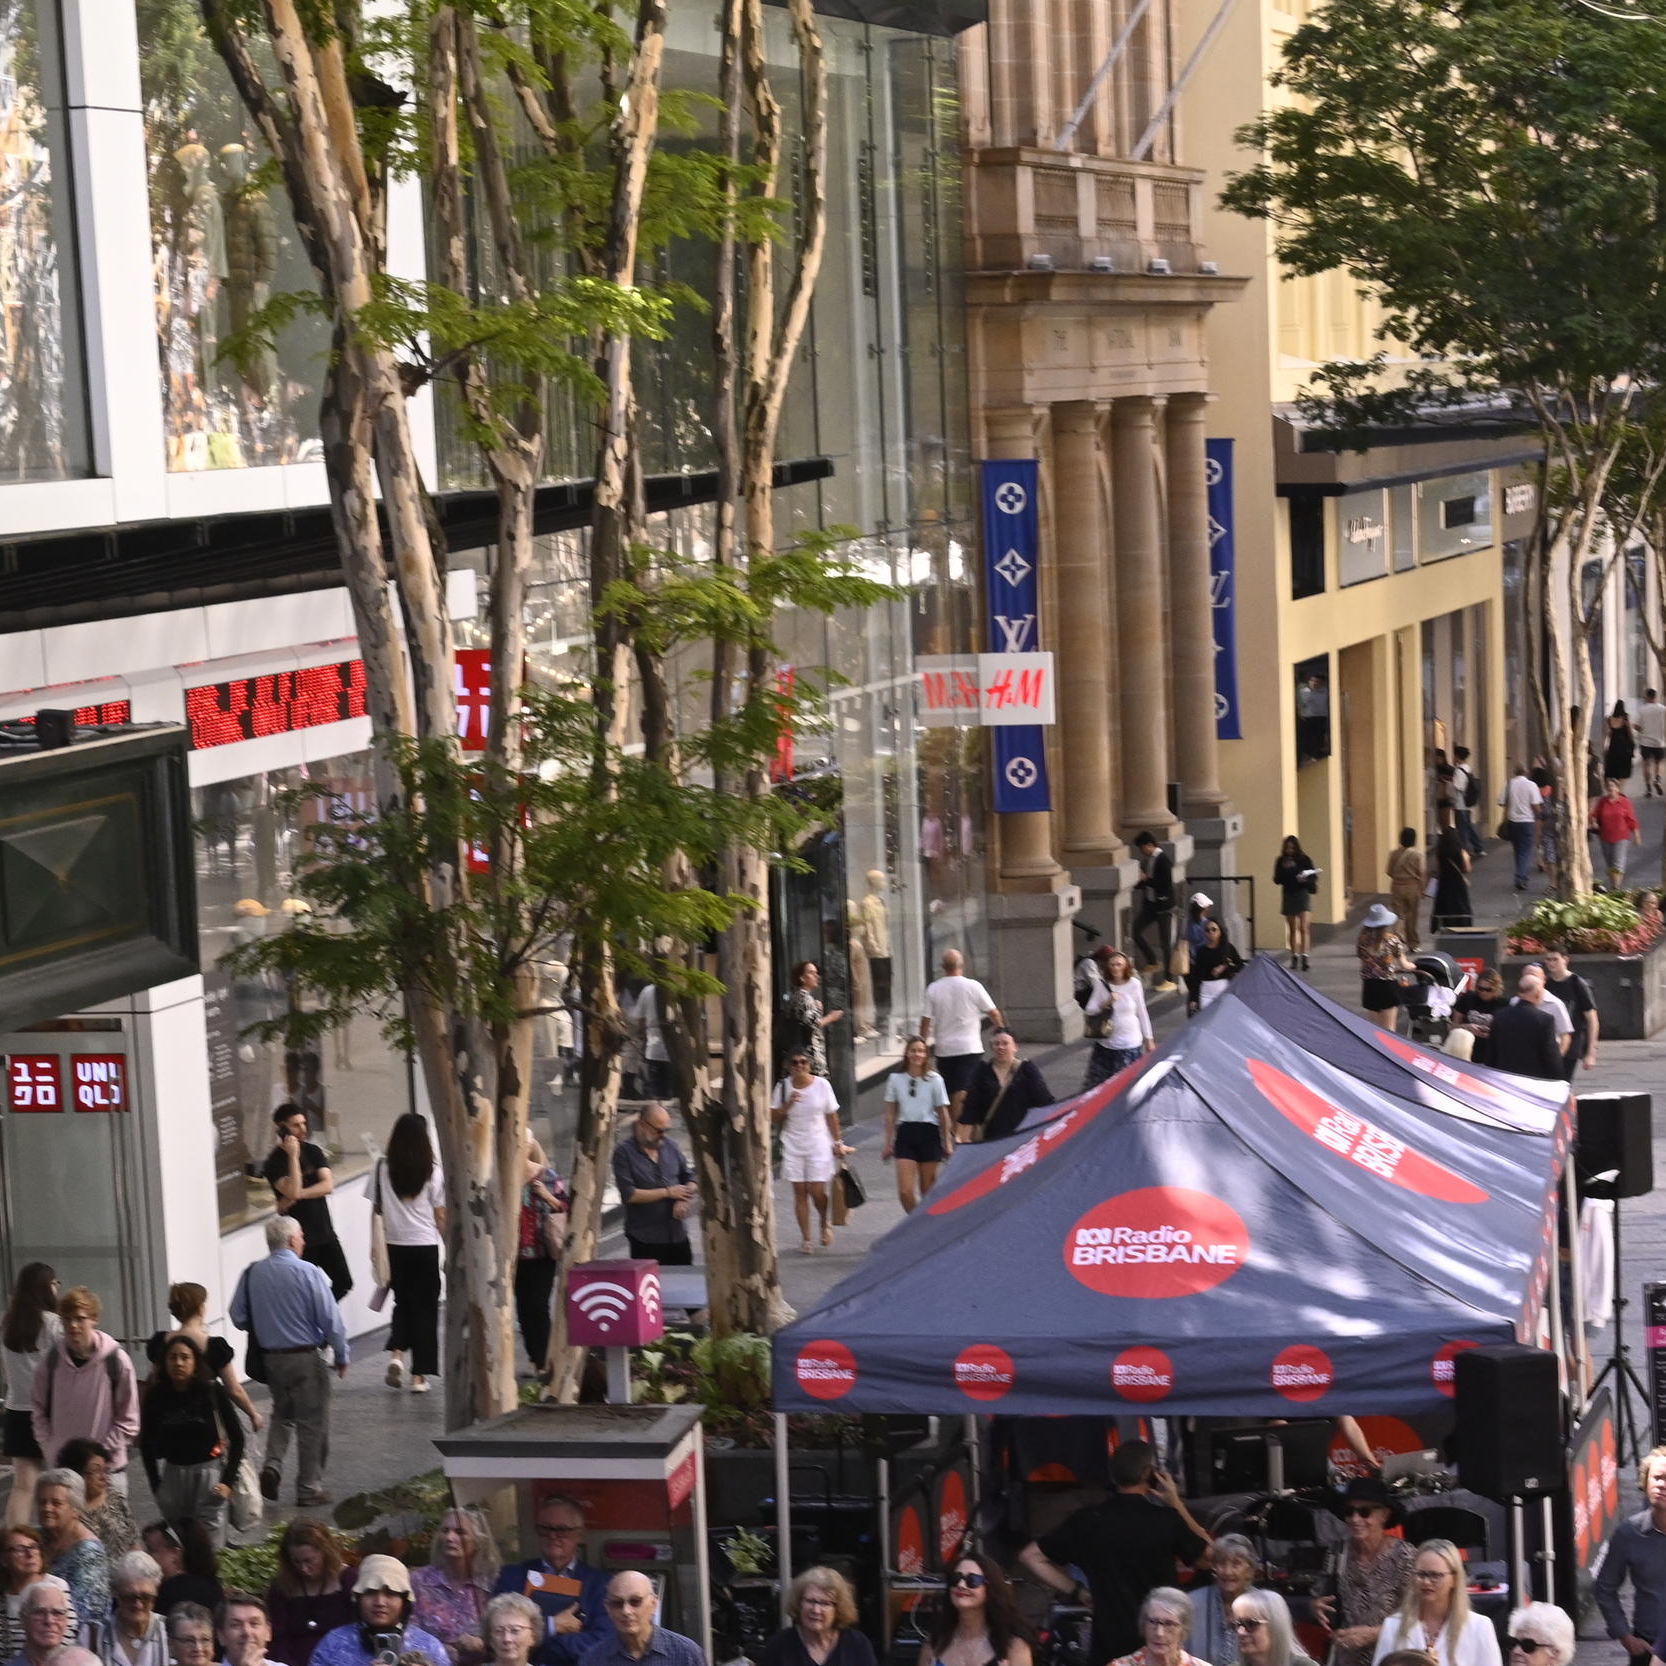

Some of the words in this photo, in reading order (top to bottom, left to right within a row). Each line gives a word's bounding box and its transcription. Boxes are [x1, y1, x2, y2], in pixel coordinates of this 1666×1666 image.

[986, 668, 1045, 710] H&M
[76, 1062, 118, 1082] UNI
[1113, 1225, 1192, 1244] Radio
[1072, 1245, 1237, 1265] BRISBANE
[811, 1358, 839, 1369] Radio
[968, 1363, 996, 1373] Radio
[797, 1369, 855, 1380] BRISBANE
[1126, 1365, 1155, 1375] Radio
[1285, 1364, 1315, 1375] Radio
[955, 1372, 1012, 1383] BRISBANE
[1113, 1374, 1170, 1386] BRISBANE
[1273, 1373, 1331, 1386] BRISBANE
